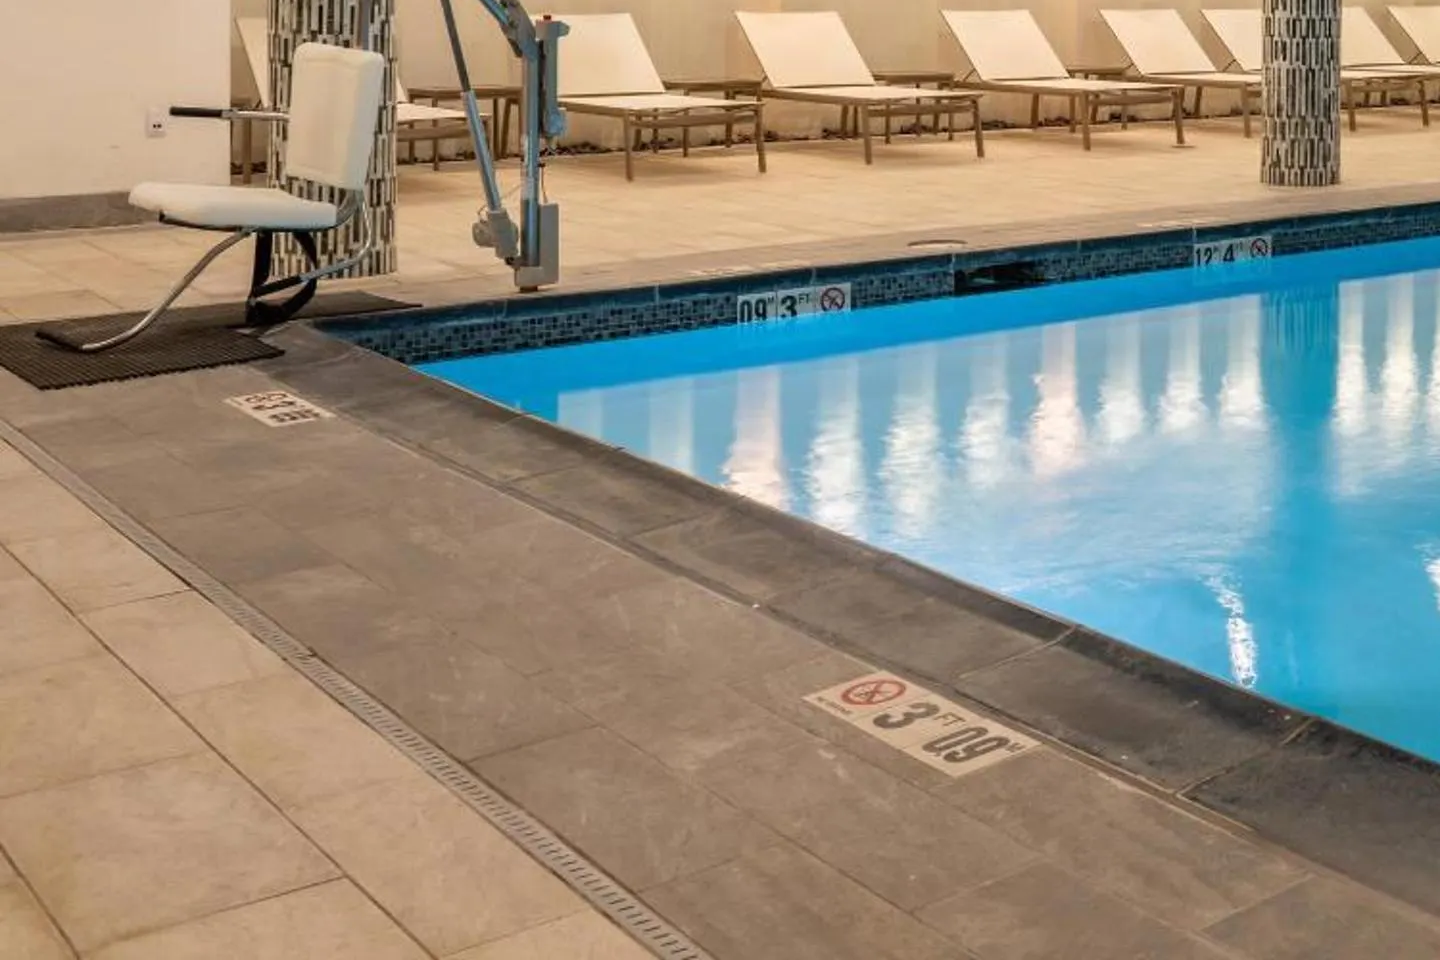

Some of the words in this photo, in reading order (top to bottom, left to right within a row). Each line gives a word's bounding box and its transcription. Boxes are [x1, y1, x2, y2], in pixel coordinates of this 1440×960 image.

[780, 295, 797, 318] 3
[873, 702, 940, 729] 3
[933, 712, 966, 727] FT
